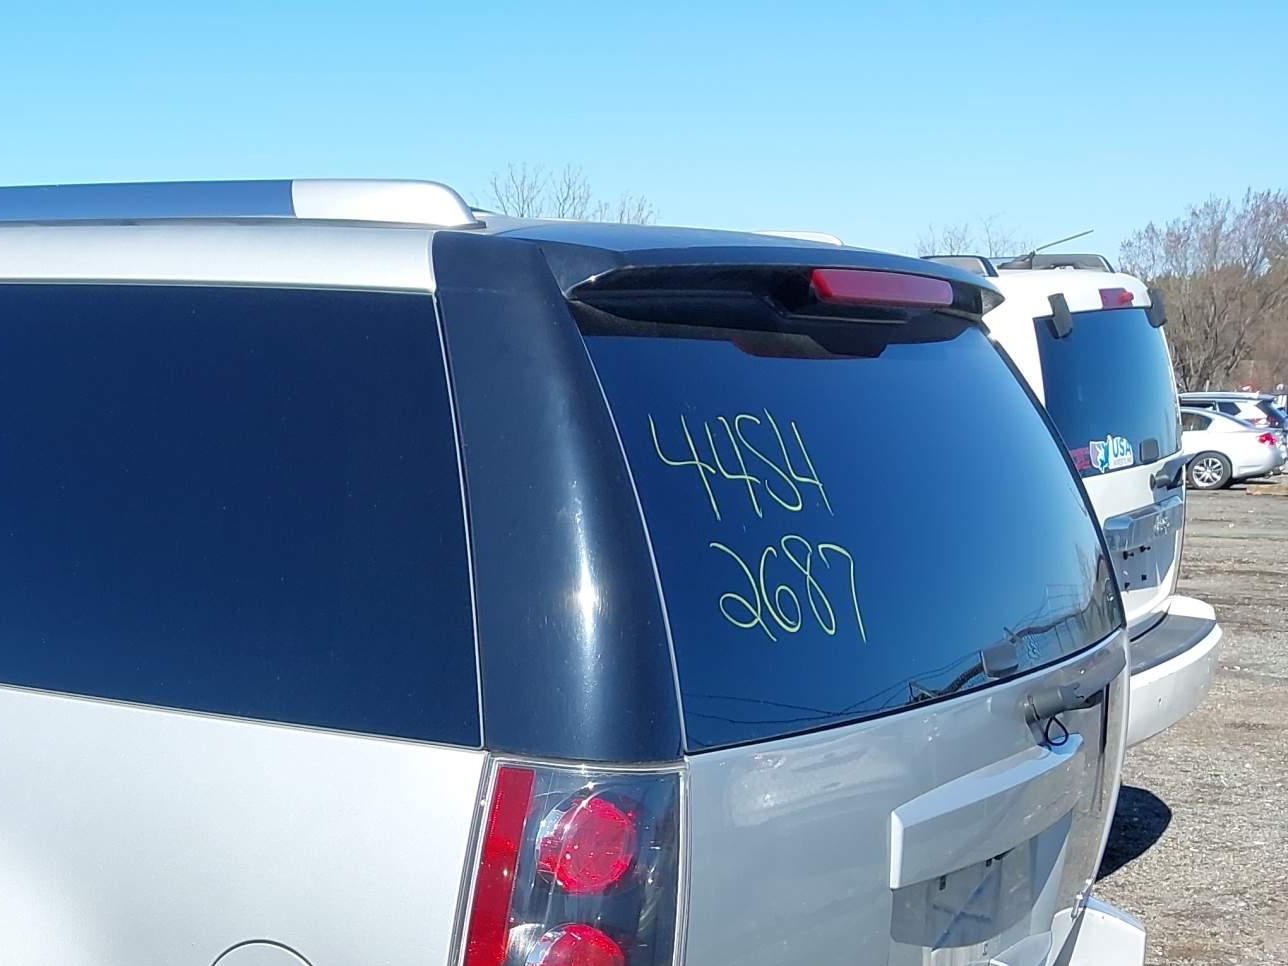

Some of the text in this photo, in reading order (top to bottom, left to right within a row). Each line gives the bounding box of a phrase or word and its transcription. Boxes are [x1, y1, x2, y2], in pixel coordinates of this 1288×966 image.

[648, 407, 835, 521] 4454
[1112, 438, 1132, 458] USA
[709, 534, 867, 644] 2687
